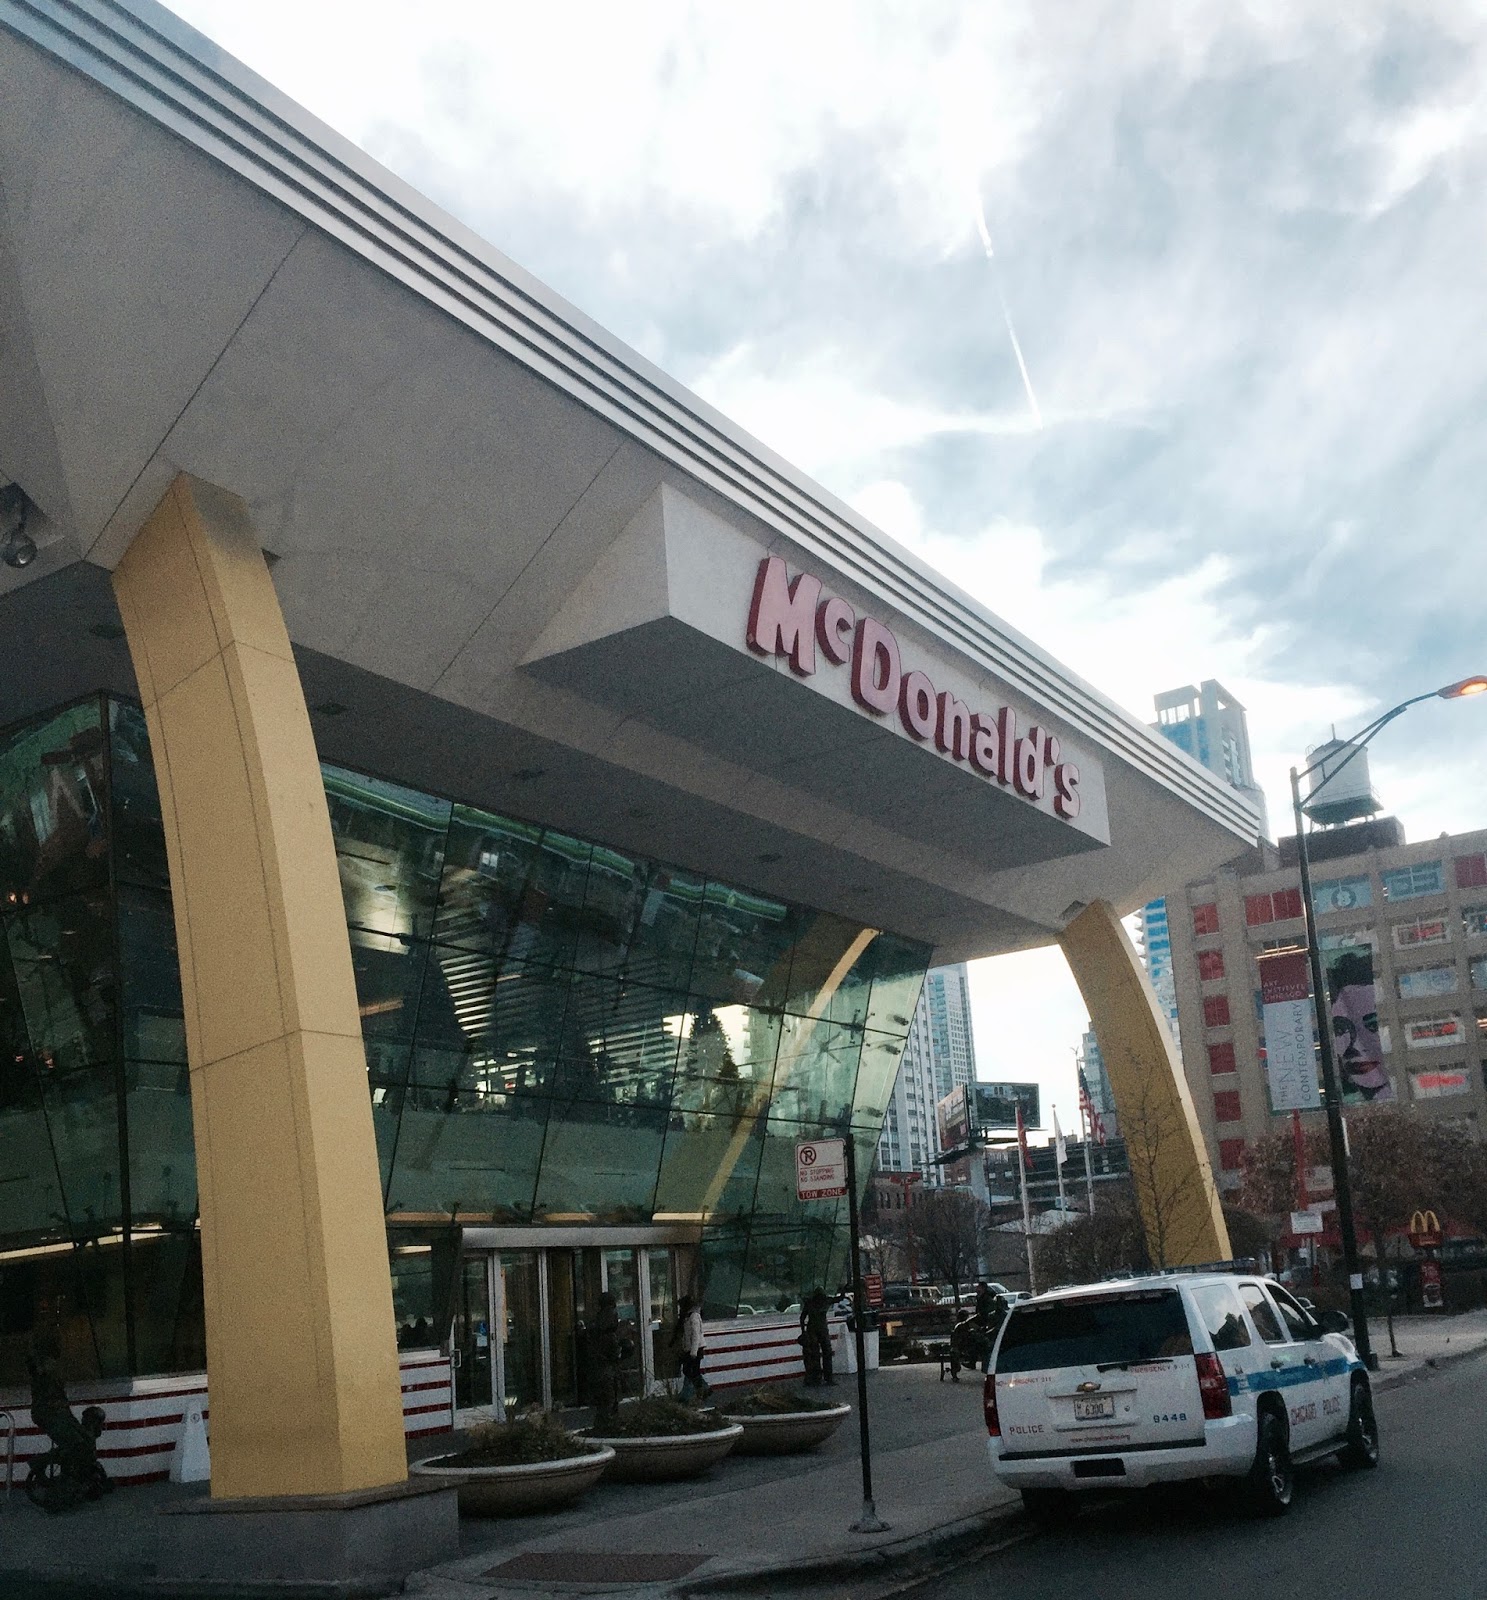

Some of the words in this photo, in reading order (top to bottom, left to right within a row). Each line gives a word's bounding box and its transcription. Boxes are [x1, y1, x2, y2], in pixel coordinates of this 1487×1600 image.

[746, 555, 1081, 820] McDonald's
[1276, 1029, 1296, 1083] NEW
[1291, 1002, 1311, 1101] CONTEMPORARY
[810, 1167, 835, 1176] STOPPING
[810, 1174, 835, 1182] STANDING
[821, 1189, 842, 1197] ZONE
[1009, 1424, 1045, 1435] POLICE
